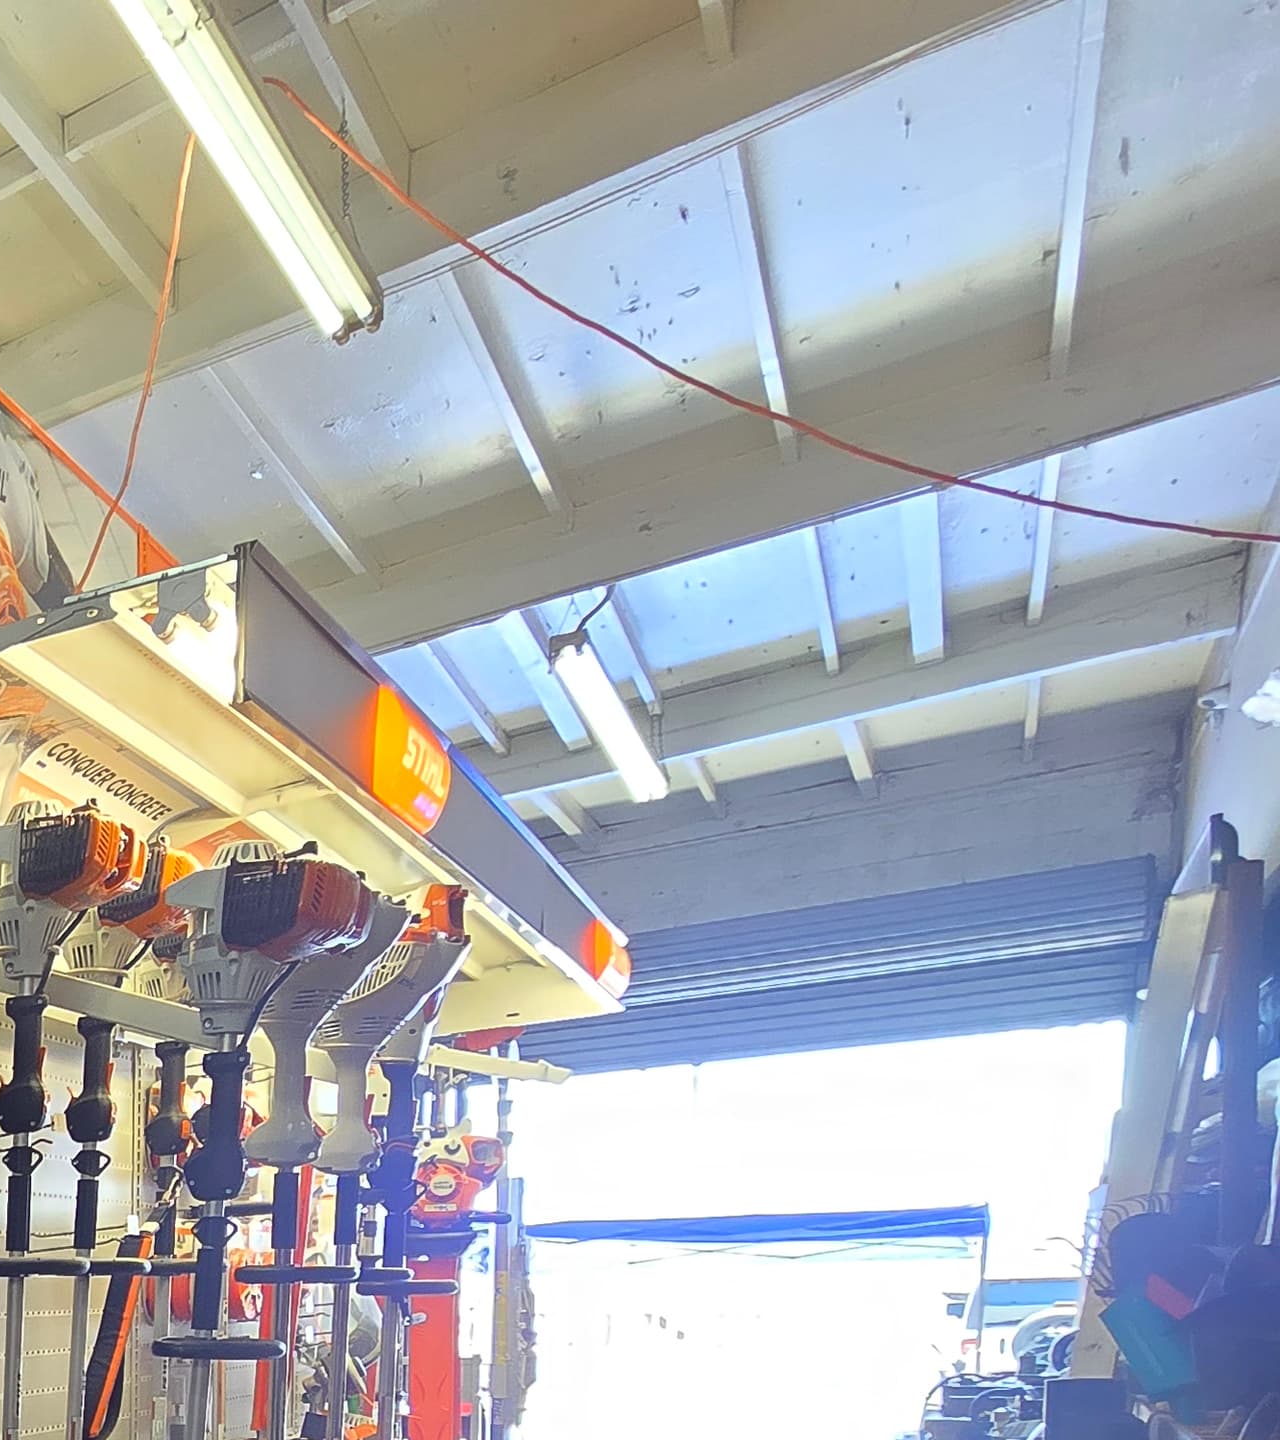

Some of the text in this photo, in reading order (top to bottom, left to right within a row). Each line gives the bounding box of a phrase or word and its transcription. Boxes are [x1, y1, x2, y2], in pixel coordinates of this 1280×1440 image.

[46, 742, 173, 821] CONQUER CONCRETE
[401, 726, 448, 798] STIHL
